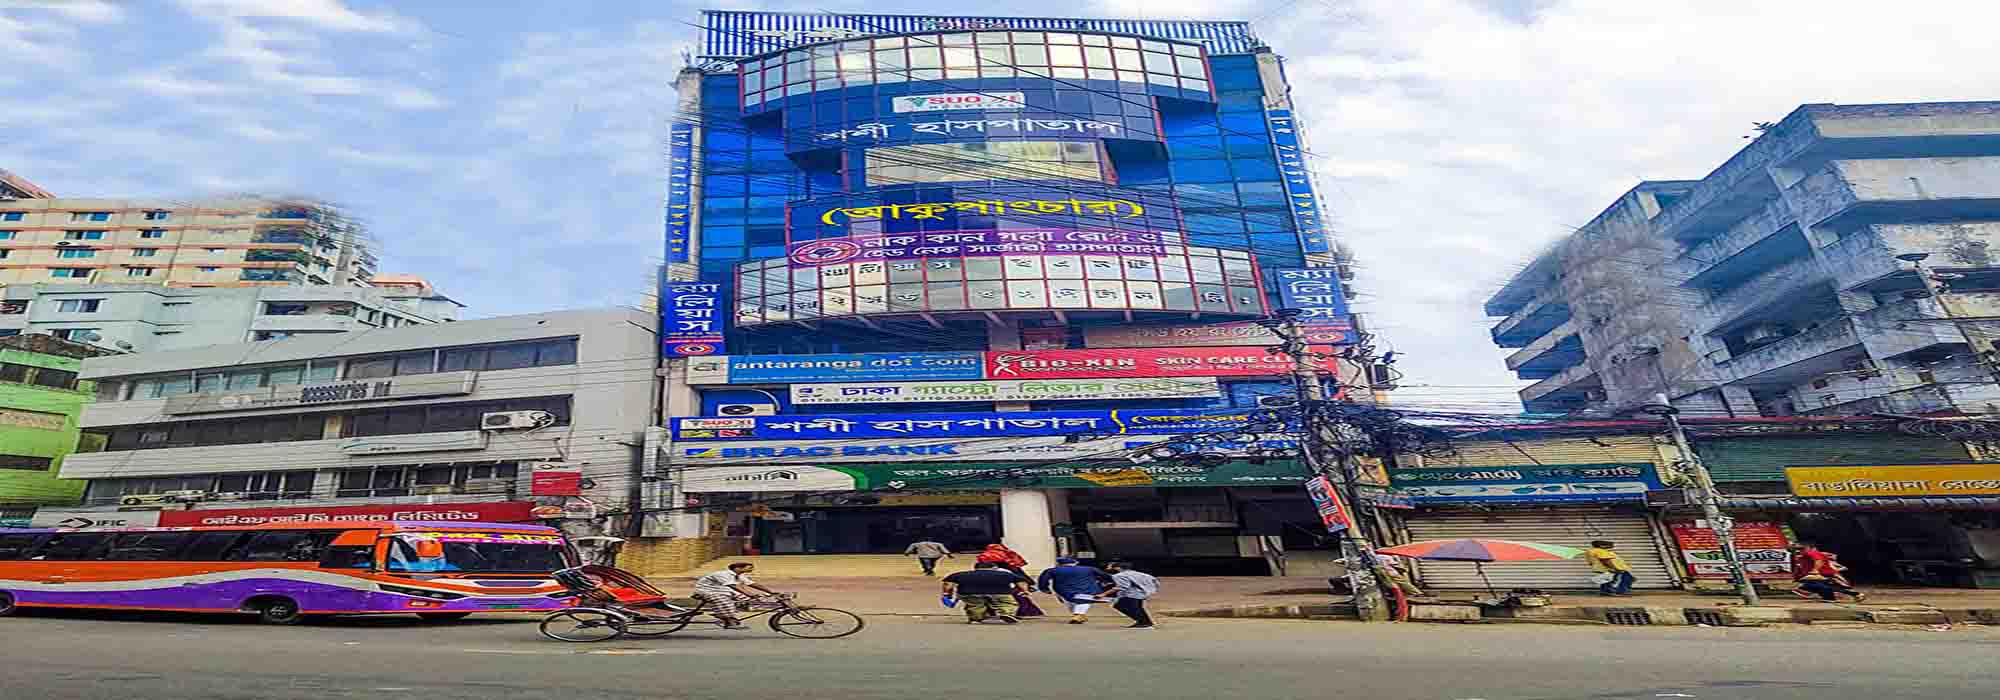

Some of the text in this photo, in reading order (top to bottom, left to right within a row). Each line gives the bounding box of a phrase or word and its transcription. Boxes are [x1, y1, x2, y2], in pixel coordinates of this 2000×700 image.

[816, 118, 1123, 141] শশী হাসপাতাল
[820, 198, 1144, 226] (আকুপাংচার)
[864, 235, 917, 247] নাক
[927, 232, 985, 243] কান
[998, 231, 1056, 242] গলা
[734, 358, 976, 370] antaranga dot com
[1155, 357, 1201, 365] SKIN
[840, 386, 902, 396] ঢাকা
[764, 416, 1102, 433] শশী হাসপাতাল
[720, 444, 959, 458] BRAC BANK
[96, 519, 127, 527] IFIC
[392, 511, 479, 522] লিমিটেড
